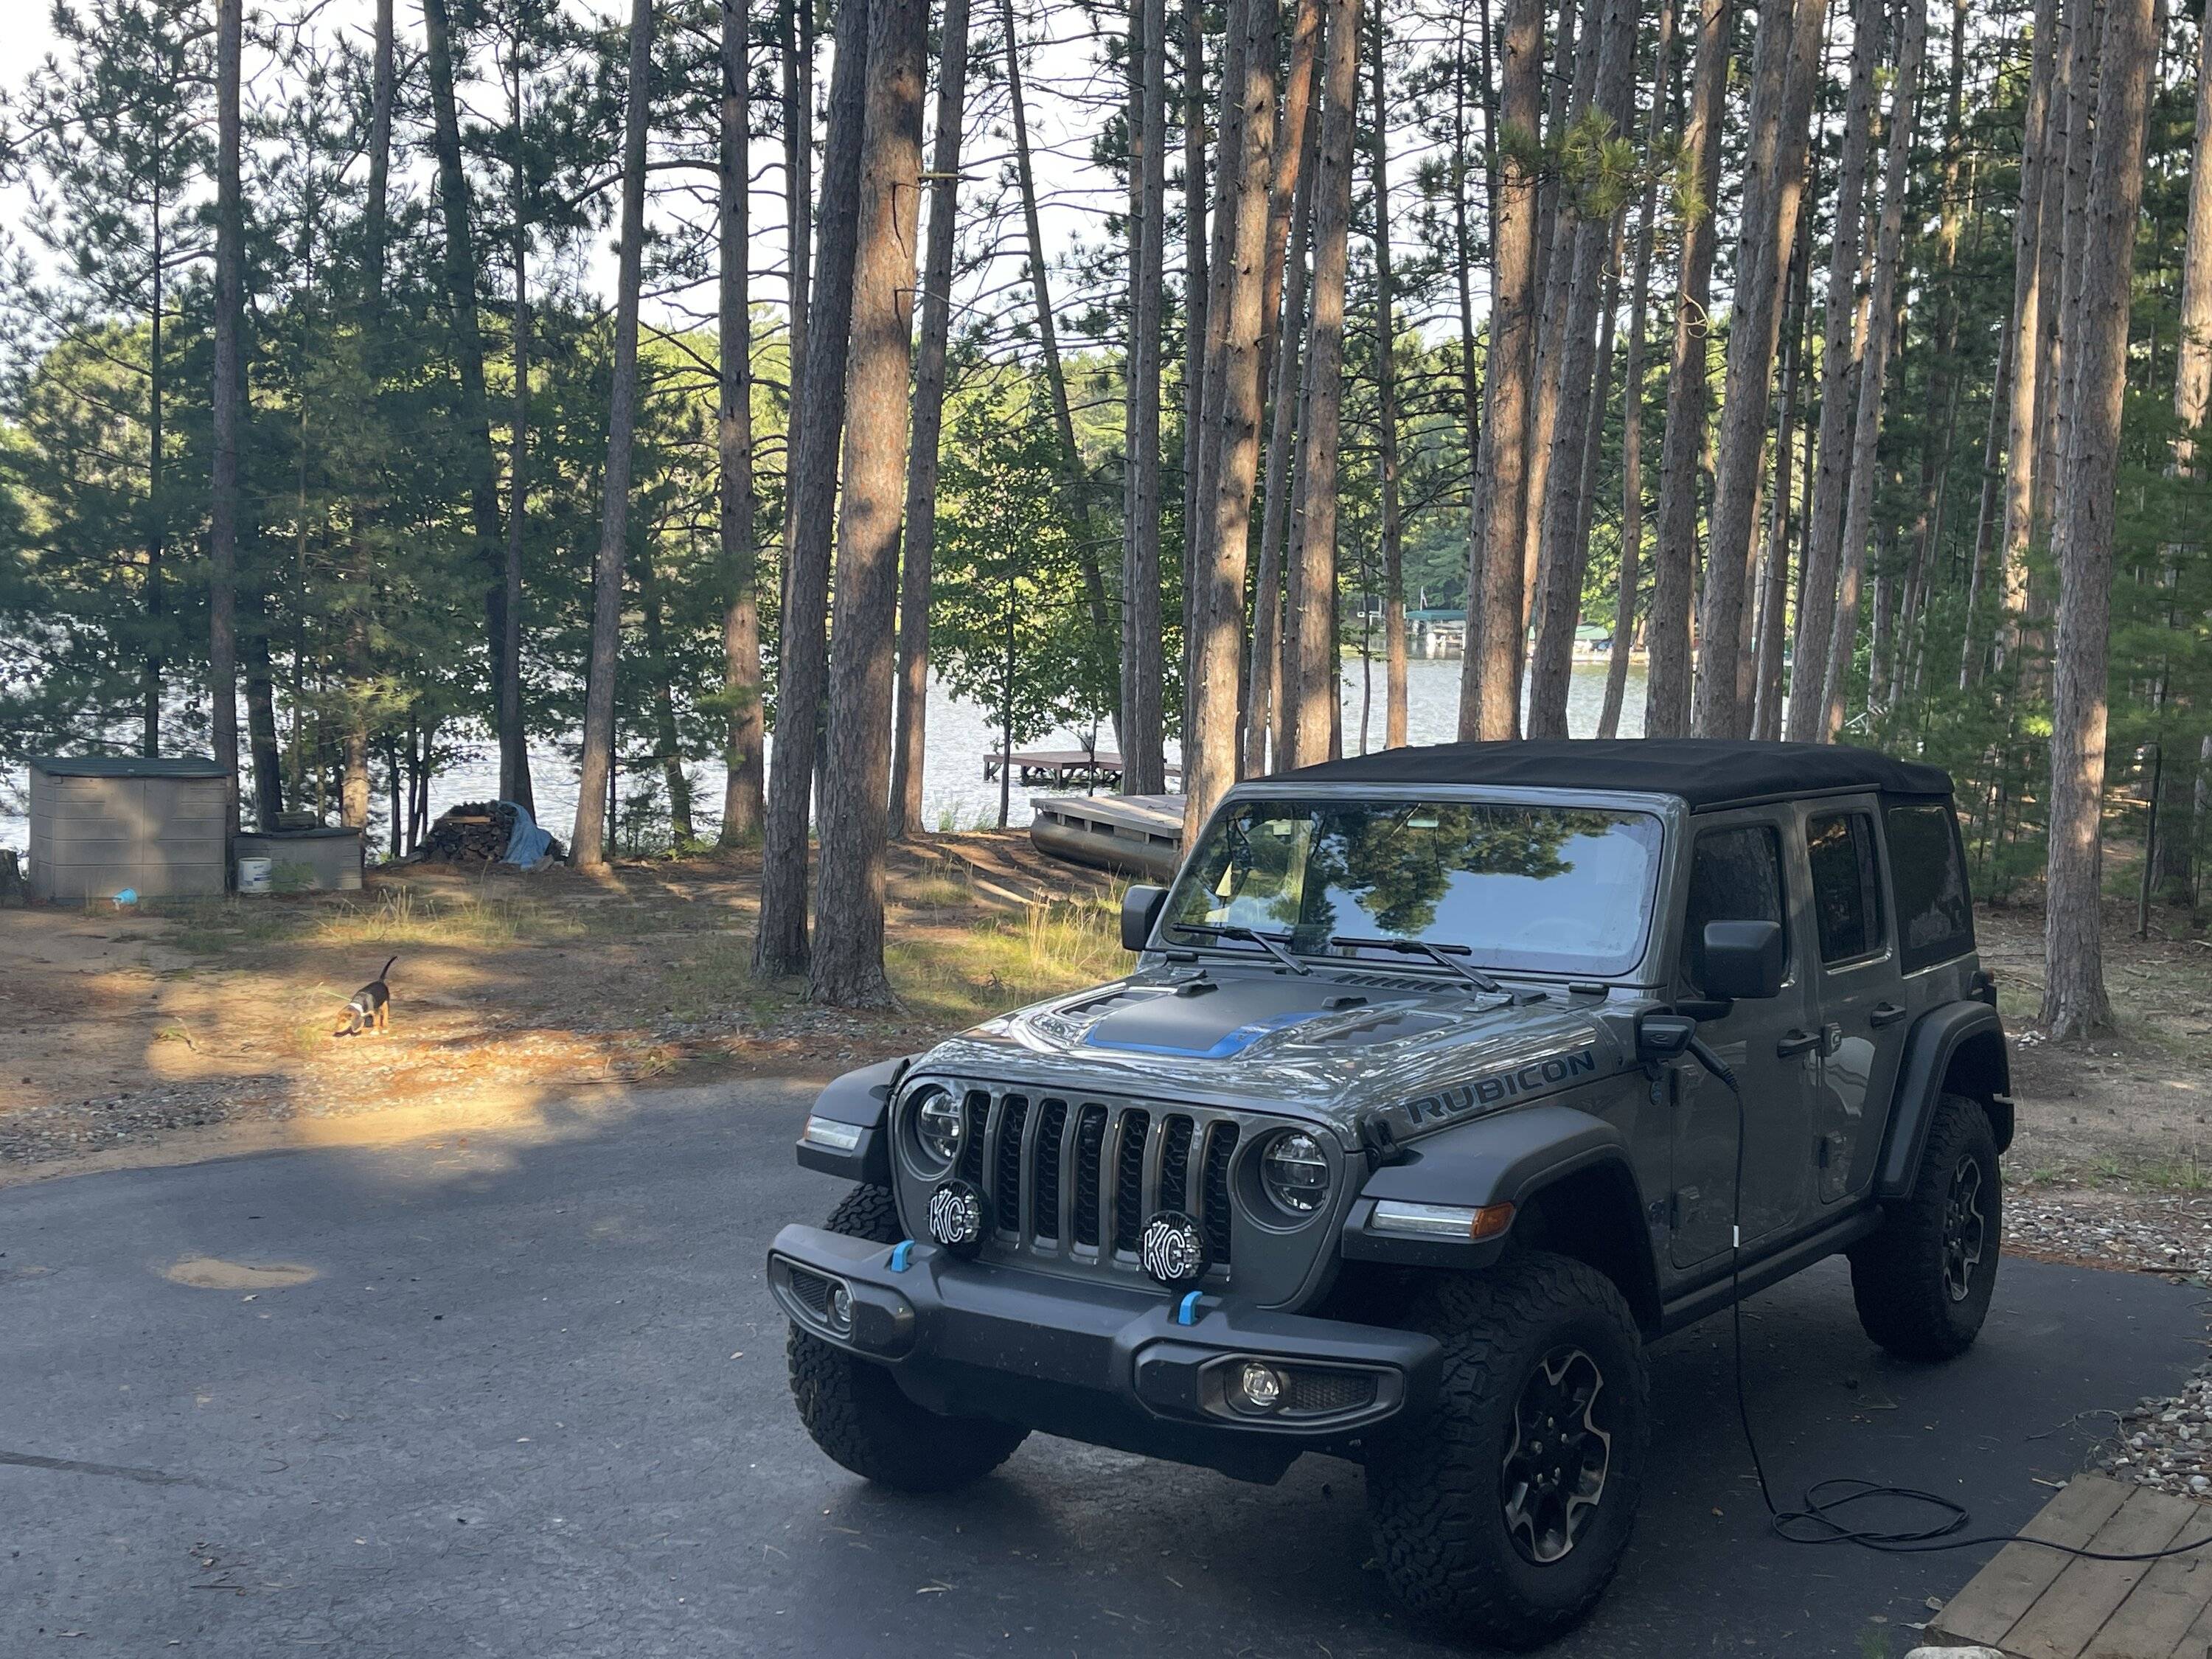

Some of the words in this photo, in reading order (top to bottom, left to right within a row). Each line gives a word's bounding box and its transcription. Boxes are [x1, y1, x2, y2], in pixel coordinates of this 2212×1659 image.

[1405, 1050, 1596, 1124] RUBICON
[929, 1189, 964, 1244] KC
[1144, 1223, 1185, 1280] KC
